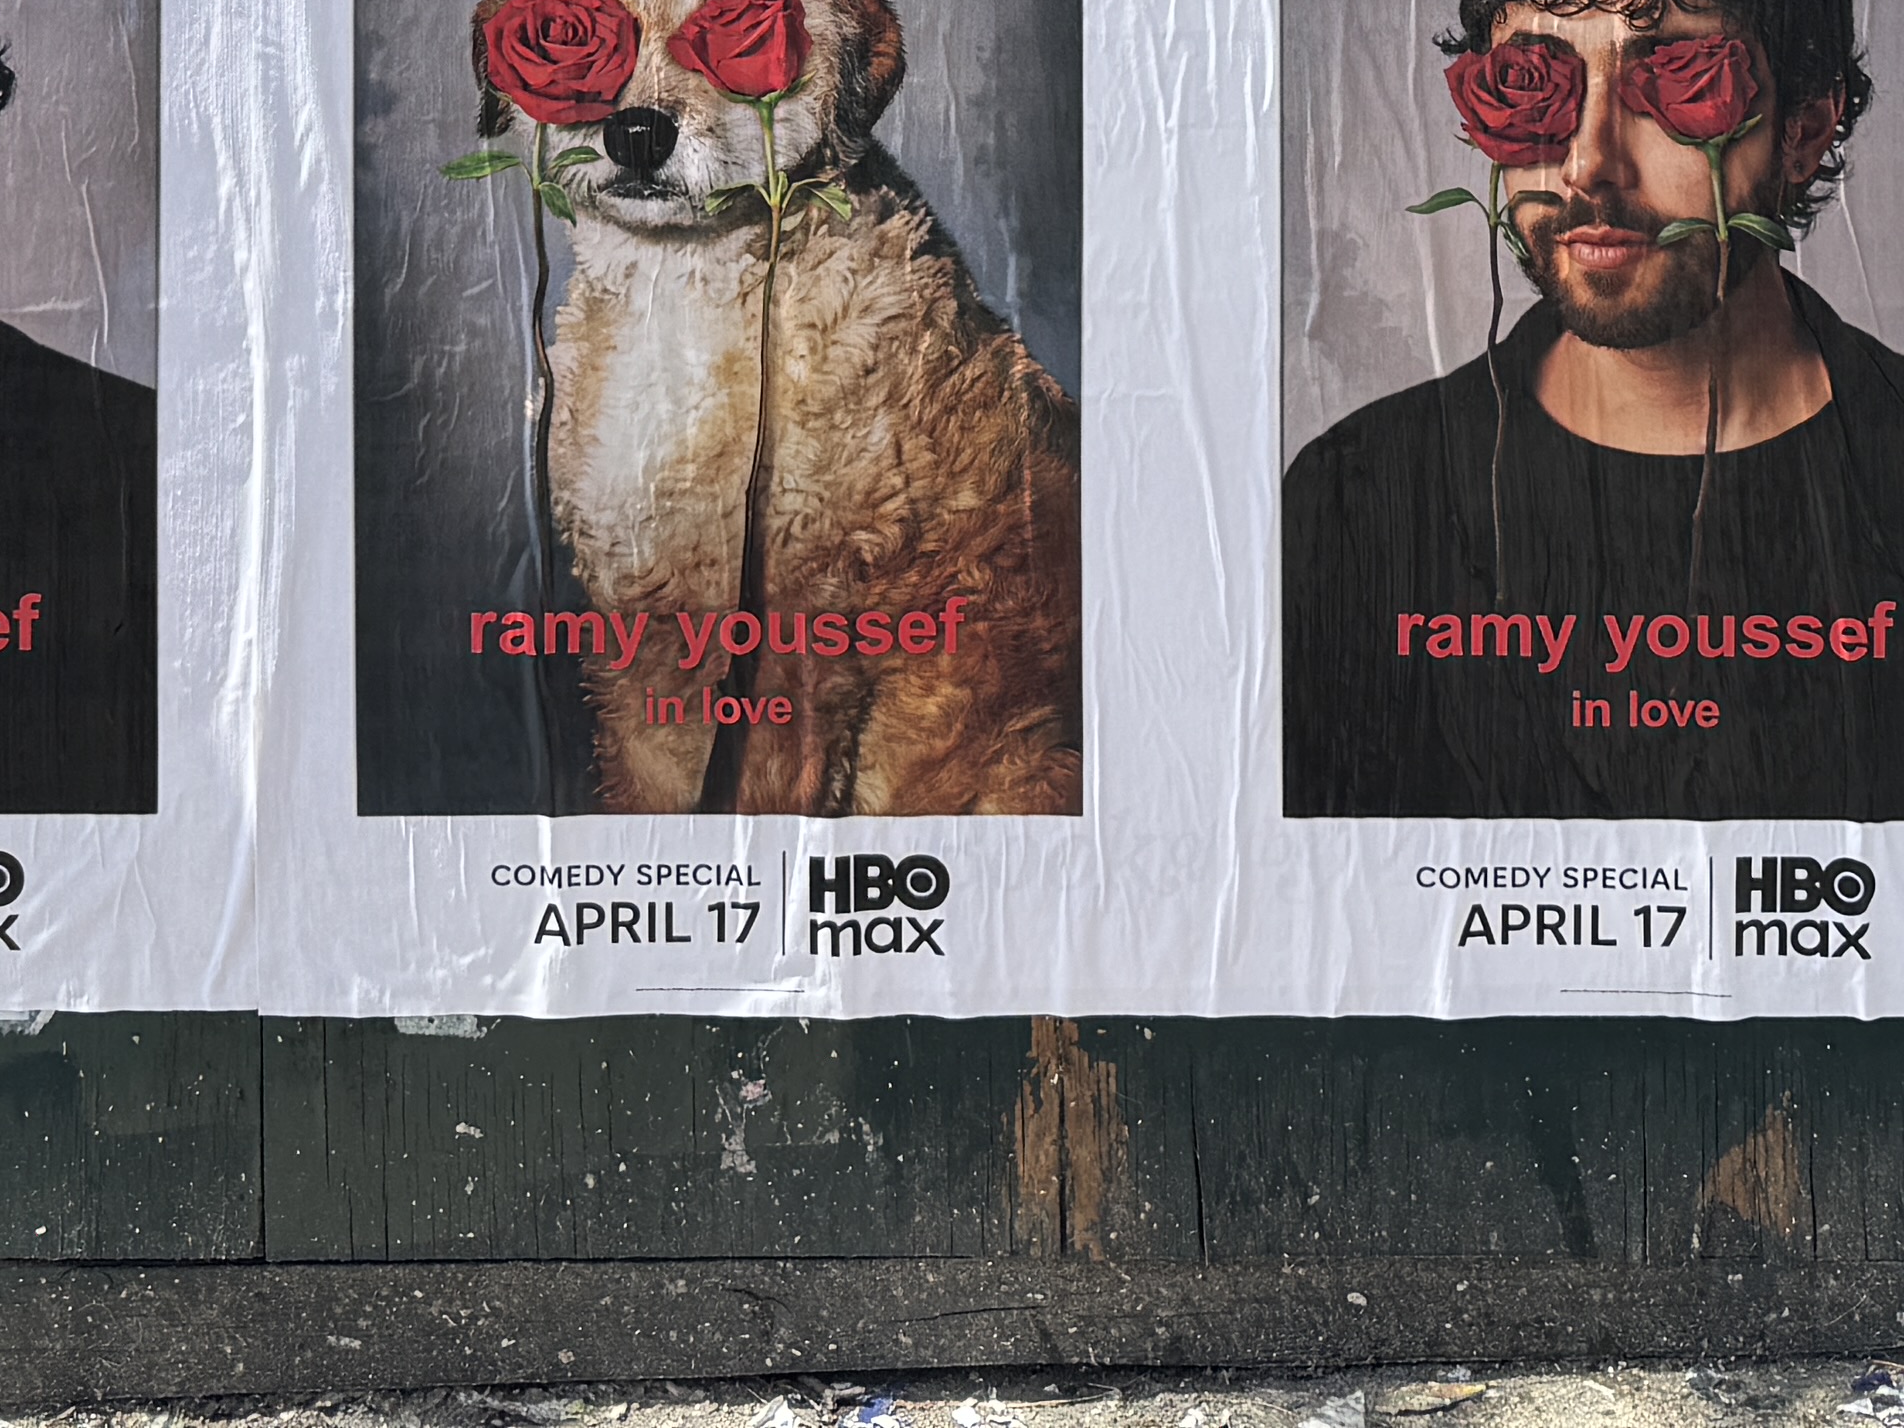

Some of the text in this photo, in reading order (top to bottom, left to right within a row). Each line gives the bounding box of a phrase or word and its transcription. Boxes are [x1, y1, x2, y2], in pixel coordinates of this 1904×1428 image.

[470, 597, 967, 670] ramy youssef
[1397, 601, 1896, 674] ramy youssef
[645, 687, 792, 725] in love
[1572, 690, 1720, 728] in love
[491, 864, 761, 889] COMEDY SPECIAL
[809, 853, 950, 914] HBO
[1416, 866, 1687, 891] COMEDY SPECIAL
[1735, 856, 1876, 916] HBO
[534, 901, 761, 947] APRIL 17
[809, 917, 944, 957] max
[1458, 904, 1687, 948] APRIL 17
[1735, 918, 1871, 960] max
